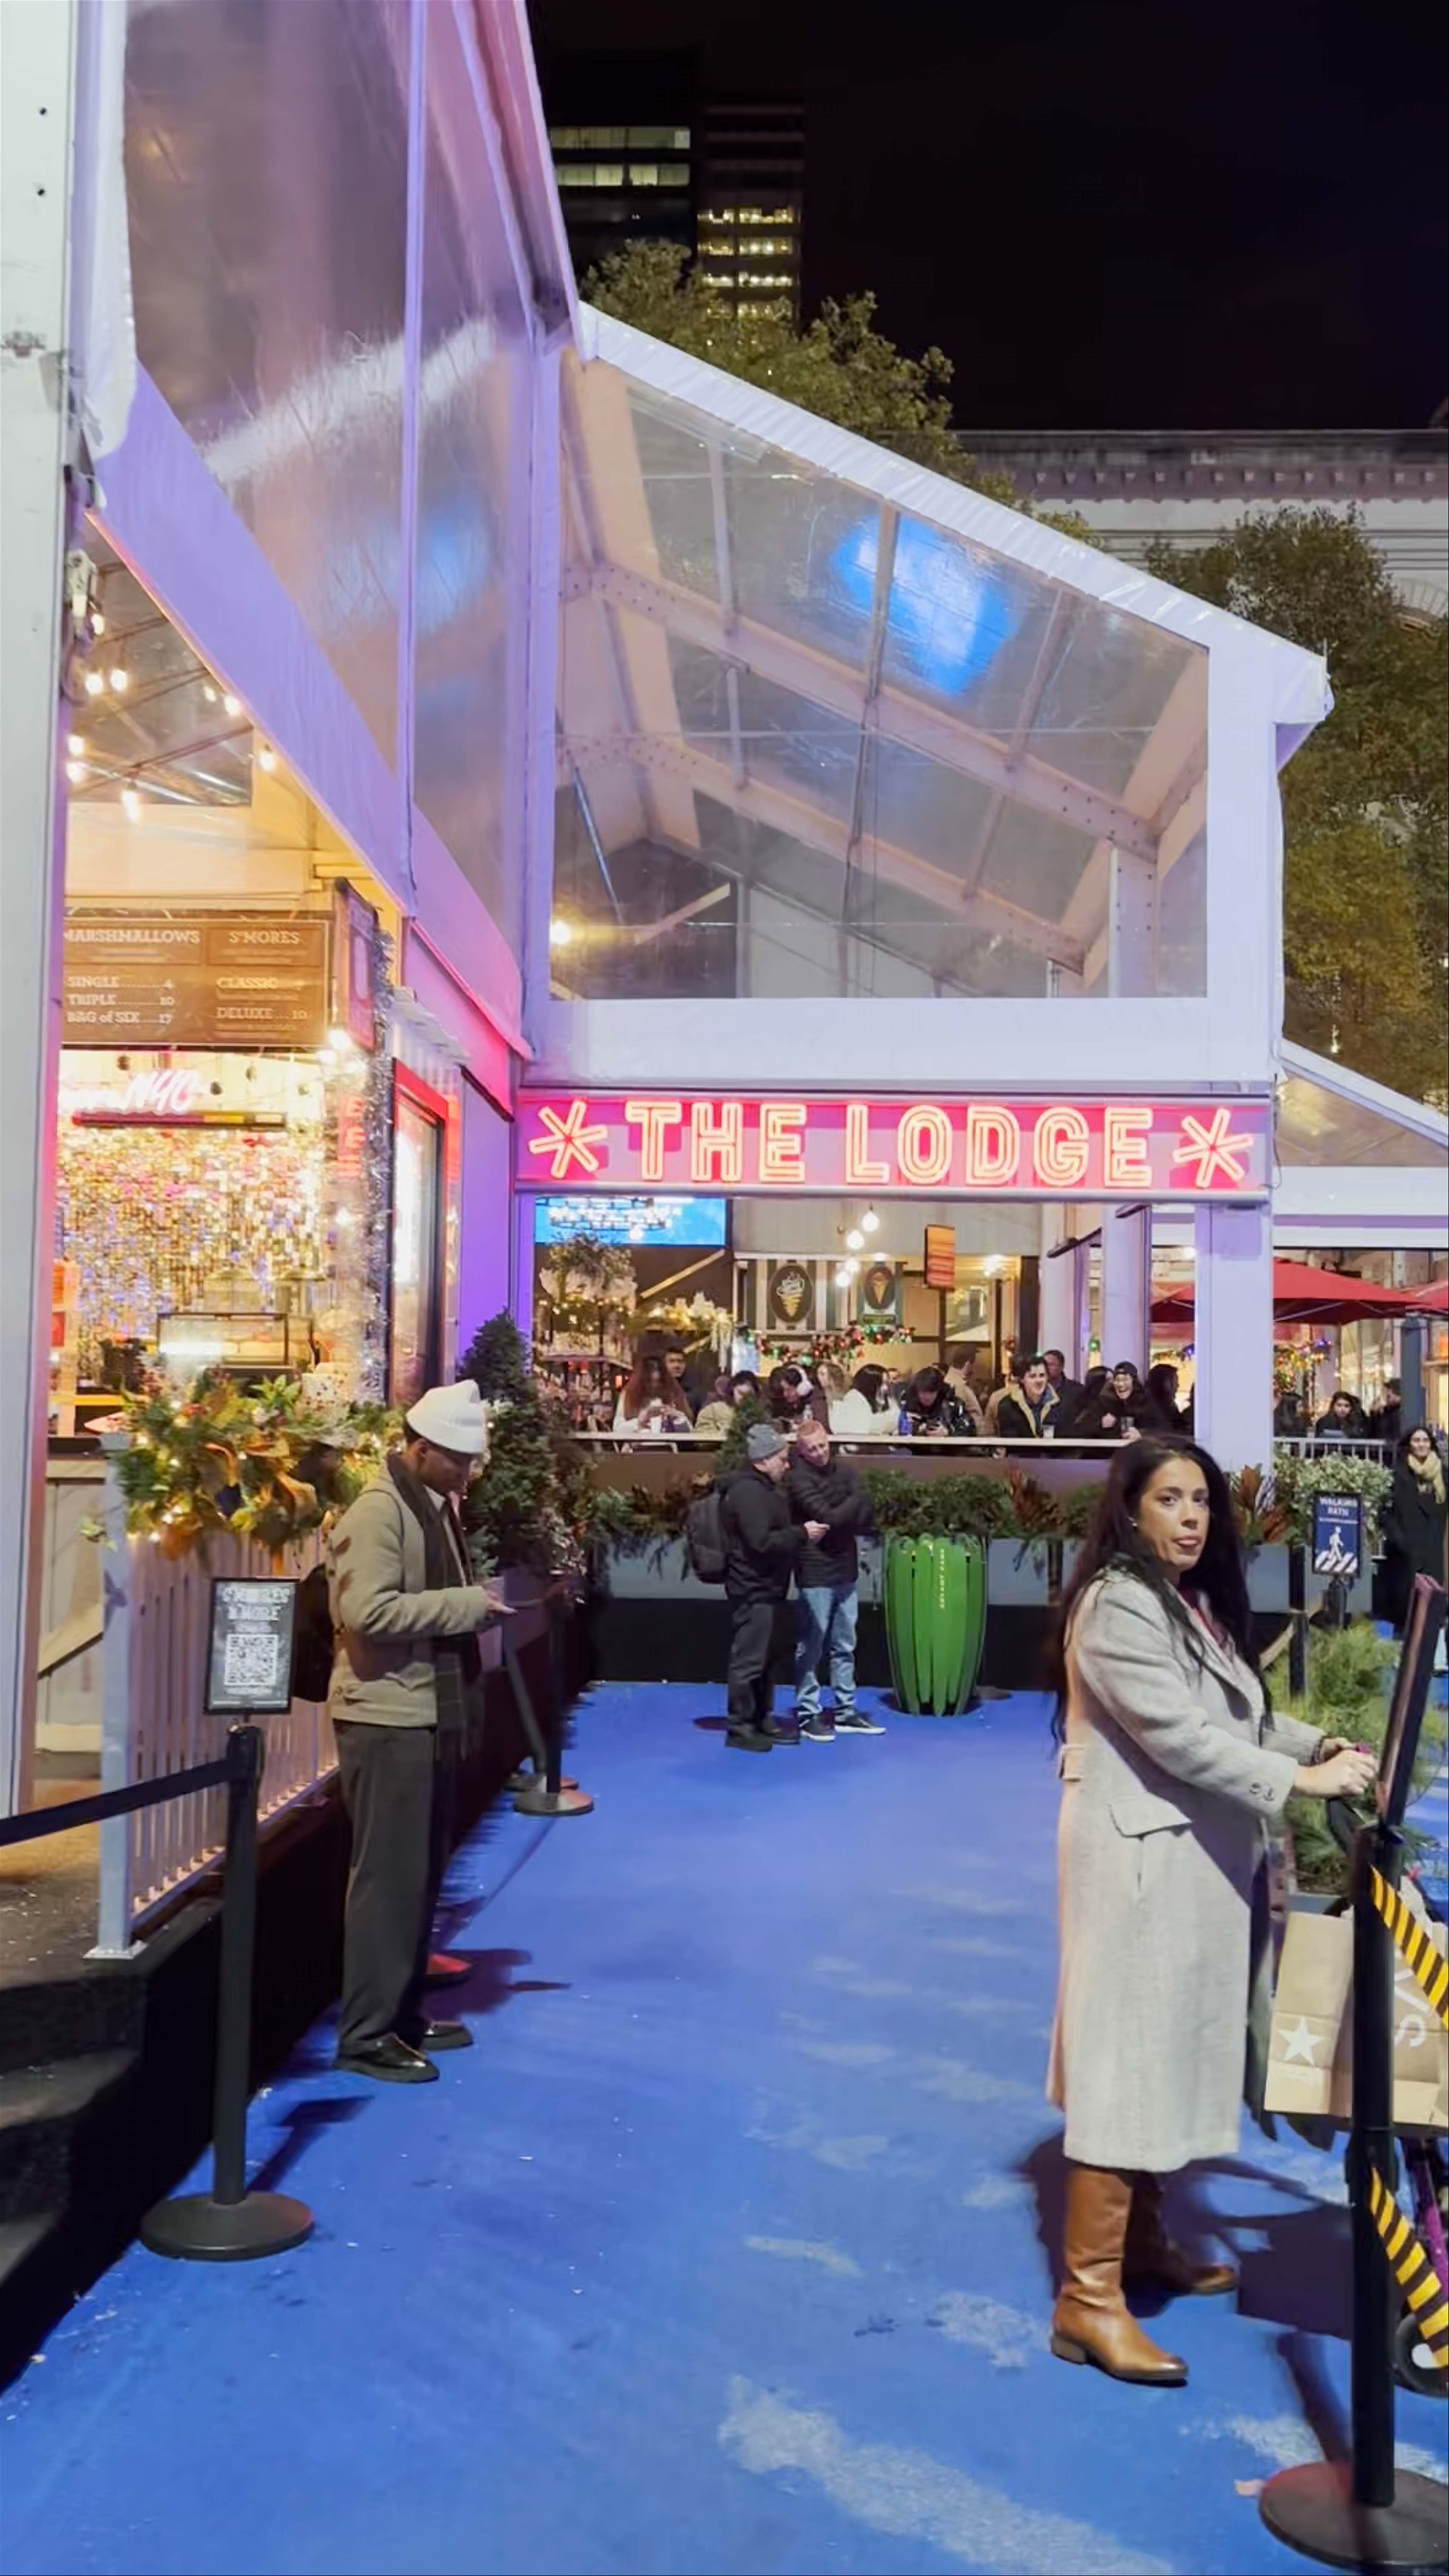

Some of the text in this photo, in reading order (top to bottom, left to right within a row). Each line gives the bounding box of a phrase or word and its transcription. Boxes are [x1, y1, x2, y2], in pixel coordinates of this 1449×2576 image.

[229, 930, 299, 944] S'MORES
[67, 977, 119, 987] SINGLE
[217, 977, 278, 989] CLASSIC
[66, 994, 116, 1005] TRIPLE
[66, 1012, 96, 1023] BAG
[99, 1011, 114, 1023] of
[115, 1012, 140, 1023] SIX
[216, 1007, 307, 1019] DELUXE 10
[625, 1102, 1153, 1187] THE LODGE
[1319, 1497, 1358, 1507] WALKING
